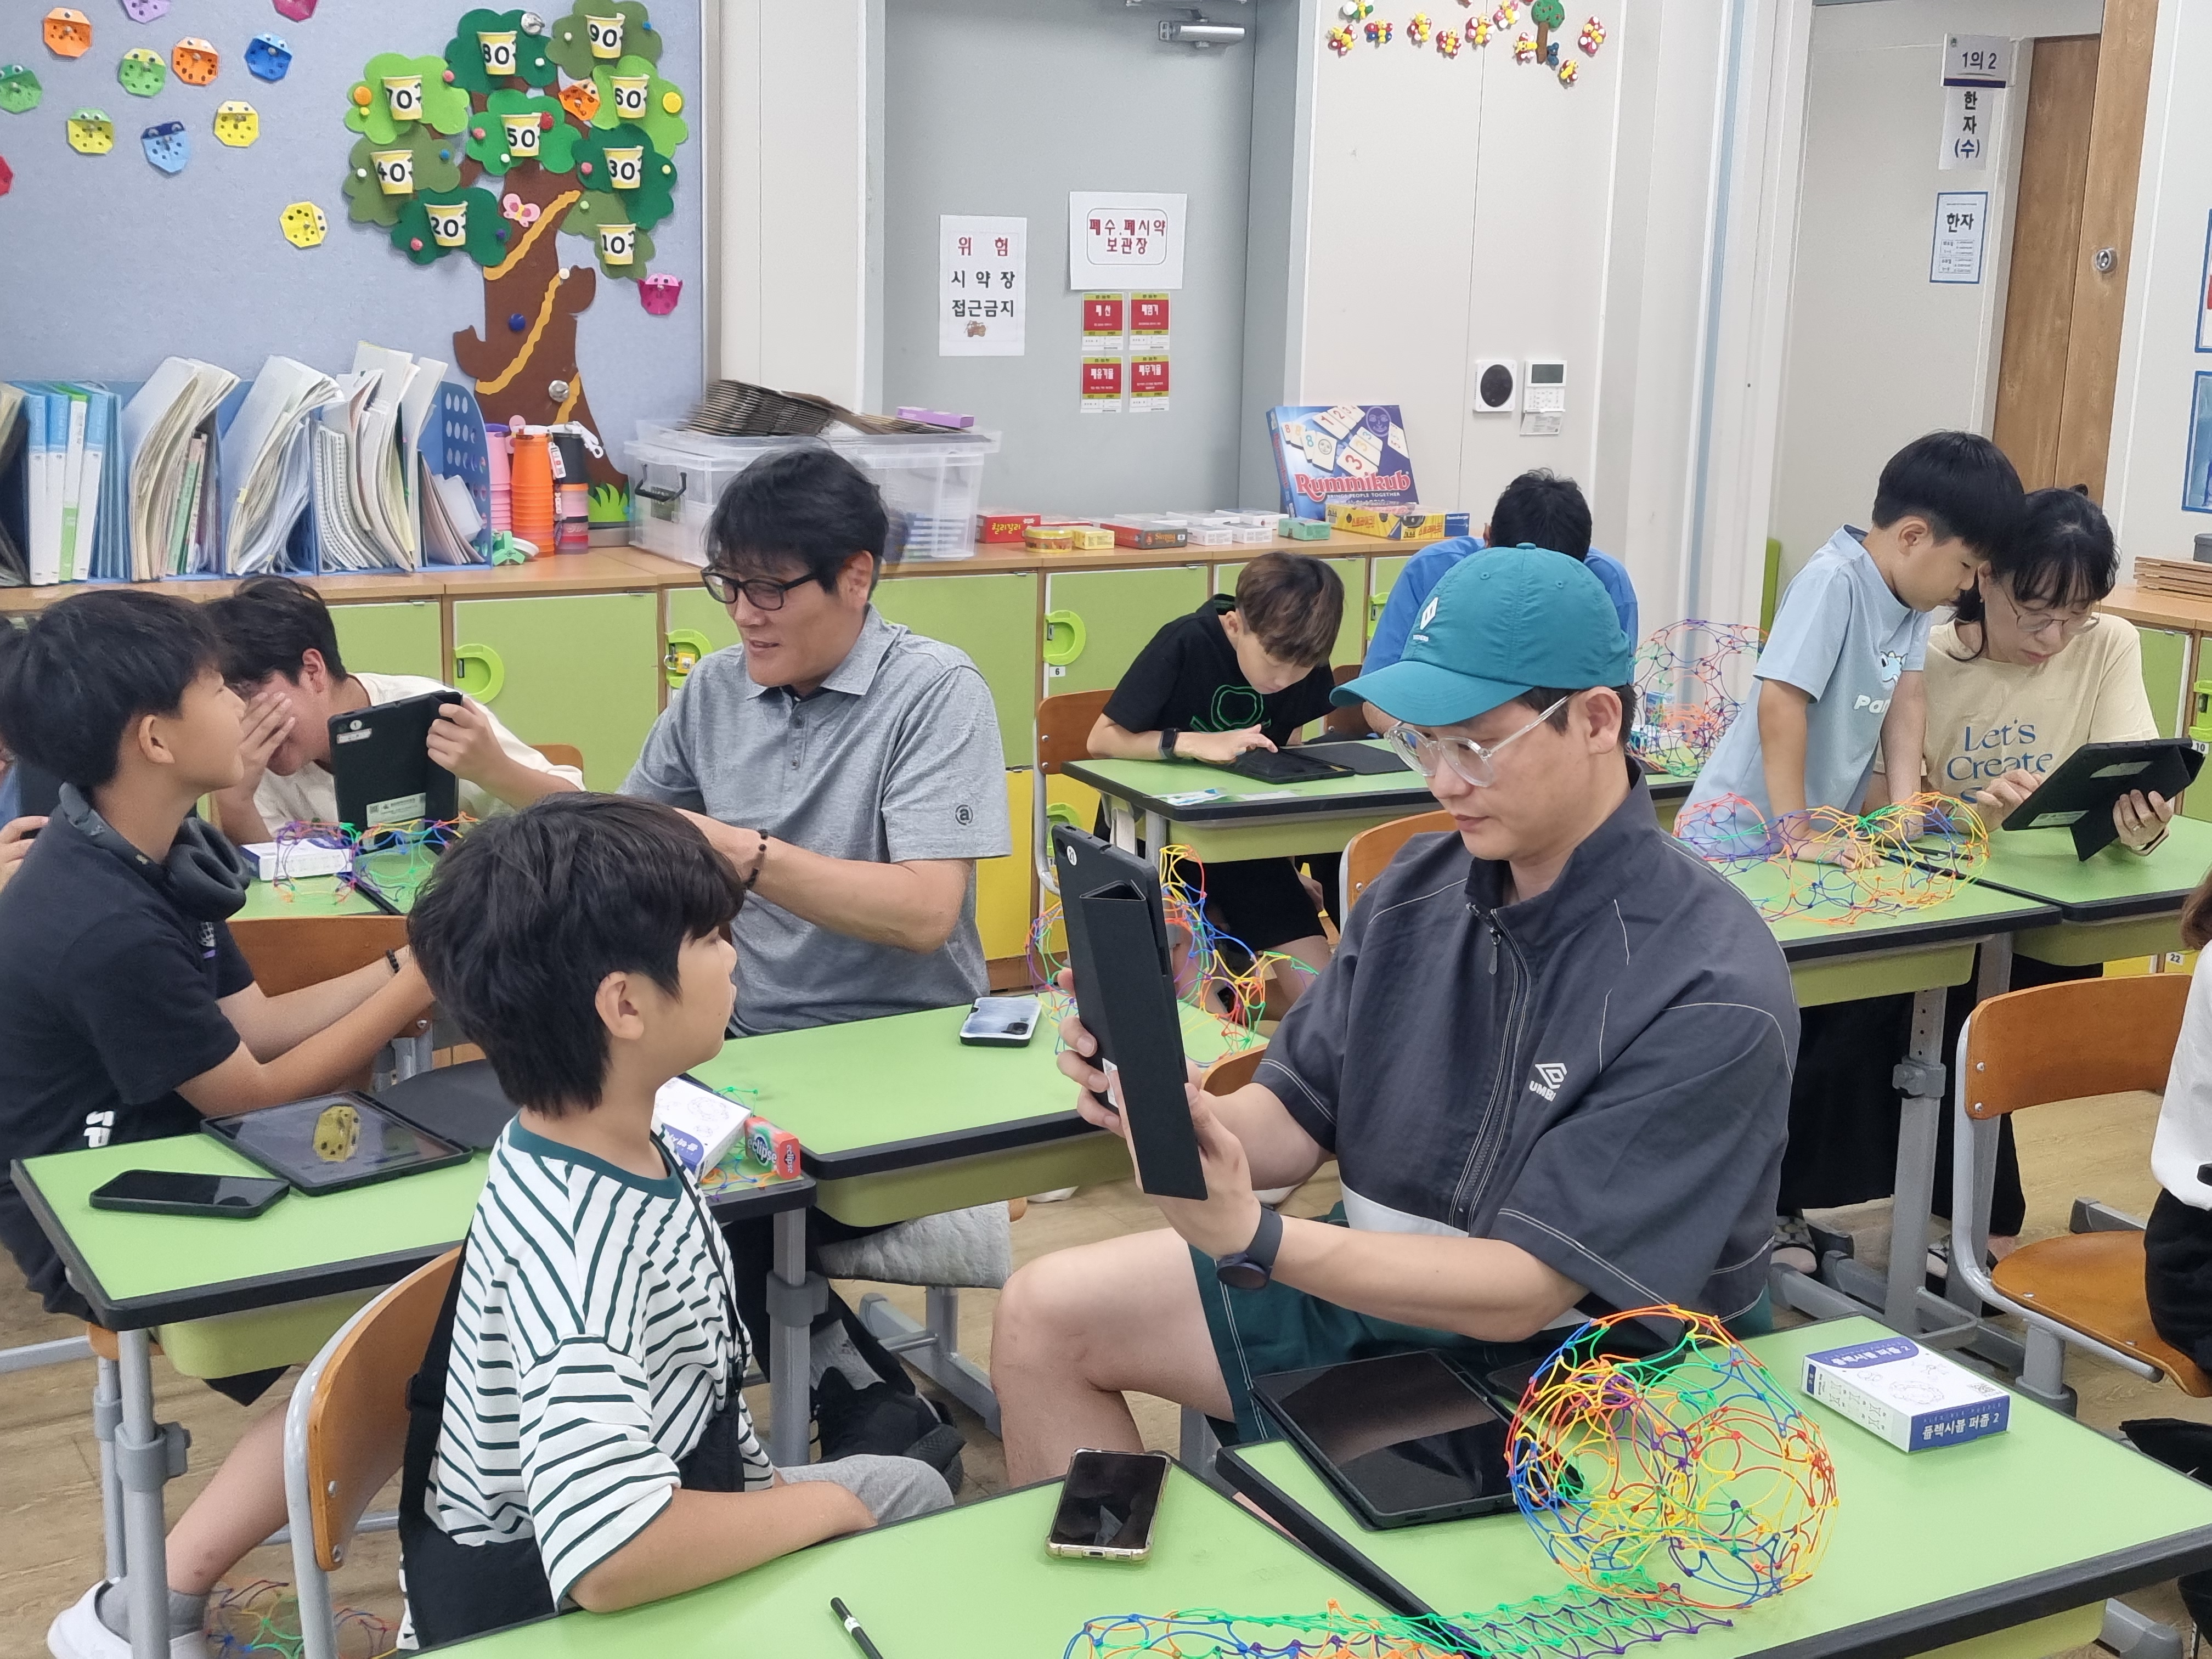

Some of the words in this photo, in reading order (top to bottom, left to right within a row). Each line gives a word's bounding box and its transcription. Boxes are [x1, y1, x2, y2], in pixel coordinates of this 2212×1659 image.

[590, 24, 617, 47] 90
[483, 43, 509, 65] 80
[615, 88, 641, 109] 60
[507, 127, 535, 147] 50
[377, 161, 405, 182] 40
[609, 160, 635, 180] 30
[431, 217, 459, 237] 20
[1946, 213, 1974, 233] 한자
[602, 234, 625, 254] 10
[1107, 238, 1147, 255] 보관장
[952, 299, 1013, 318] 접근금지
[1321, 416, 1334, 425] 1
[1333, 410, 1345, 419] 2
[1285, 424, 1291, 433] 8
[1306, 435, 1314, 447] 8
[1345, 455, 1362, 470] 3
[1295, 470, 1411, 502] Rummikub
[992, 522, 1021, 534] 할리갈리
[1964, 719, 2036, 752] Let's
[2196, 743, 2205, 752] 10
[1947, 752, 2053, 781] Create
[2170, 953, 2181, 963] 22
[747, 1137, 777, 1165] eclipse
[784, 1144, 794, 1174] eclipse
[1922, 1418, 1966, 1440] 플렉시블
[1969, 1413, 1990, 1430] 퍼즐
[1993, 1412, 2000, 1424] 2
